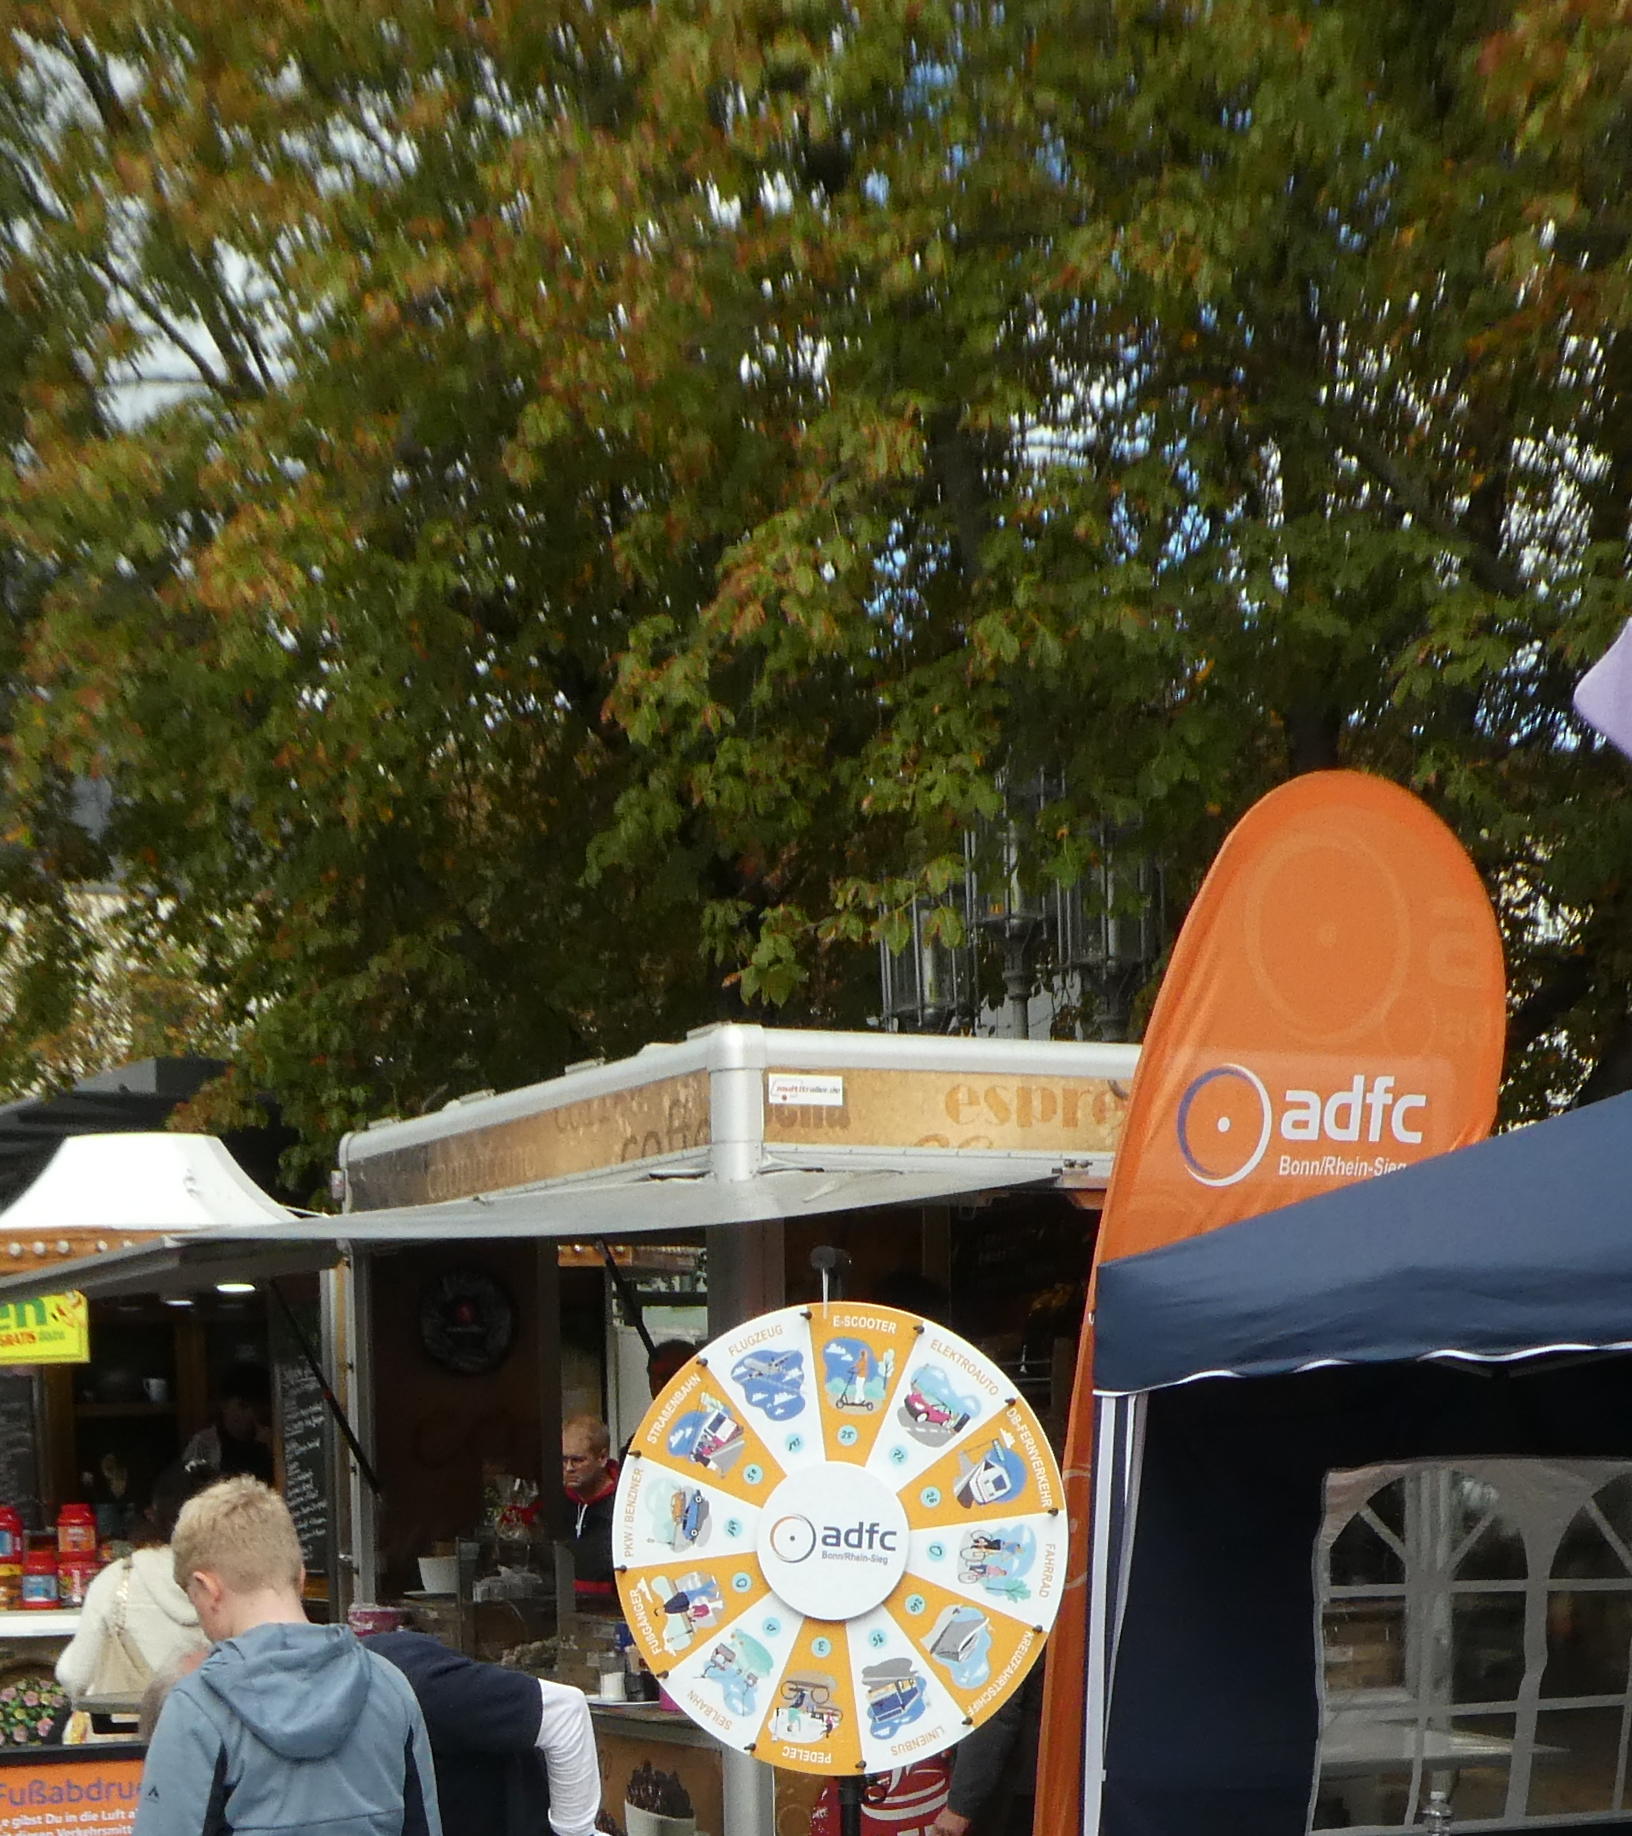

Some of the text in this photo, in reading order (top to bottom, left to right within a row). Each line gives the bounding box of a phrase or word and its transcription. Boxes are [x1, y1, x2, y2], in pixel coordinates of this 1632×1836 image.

[1281, 1075, 1427, 1144] adfc
[727, 1323, 783, 1357] FLUGZEUG
[833, 1315, 897, 1334] E-SCOOTER
[928, 1339, 999, 1397] ELEKTROAUTO
[646, 1372, 702, 1444] STRAßENBAHN
[841, 1430, 853, 1441] 25
[1004, 1407, 1053, 1507] DB-FERNVERKEHR
[623, 1466, 644, 1522] BENZINER
[623, 1531, 634, 1557] PKW
[821, 1521, 898, 1552] adfc
[821, 1550, 889, 1567] Bonn/Rhein-Sieg
[1037, 1543, 1055, 1598] FAHRRAD
[964, 1630, 1035, 1717] KREUZFAHRTSCHIFF
[686, 1688, 733, 1731] SEILBAHN
[781, 1744, 831, 1764] PEDELEC
[889, 1725, 945, 1756] LINIENBUS
[12, 1814, 43, 1829] gibst
[45, 1813, 63, 1825] Du
[65, 1811, 77, 1823] in
[79, 1810, 99, 1823] die
[101, 1808, 125, 1821] Luft
